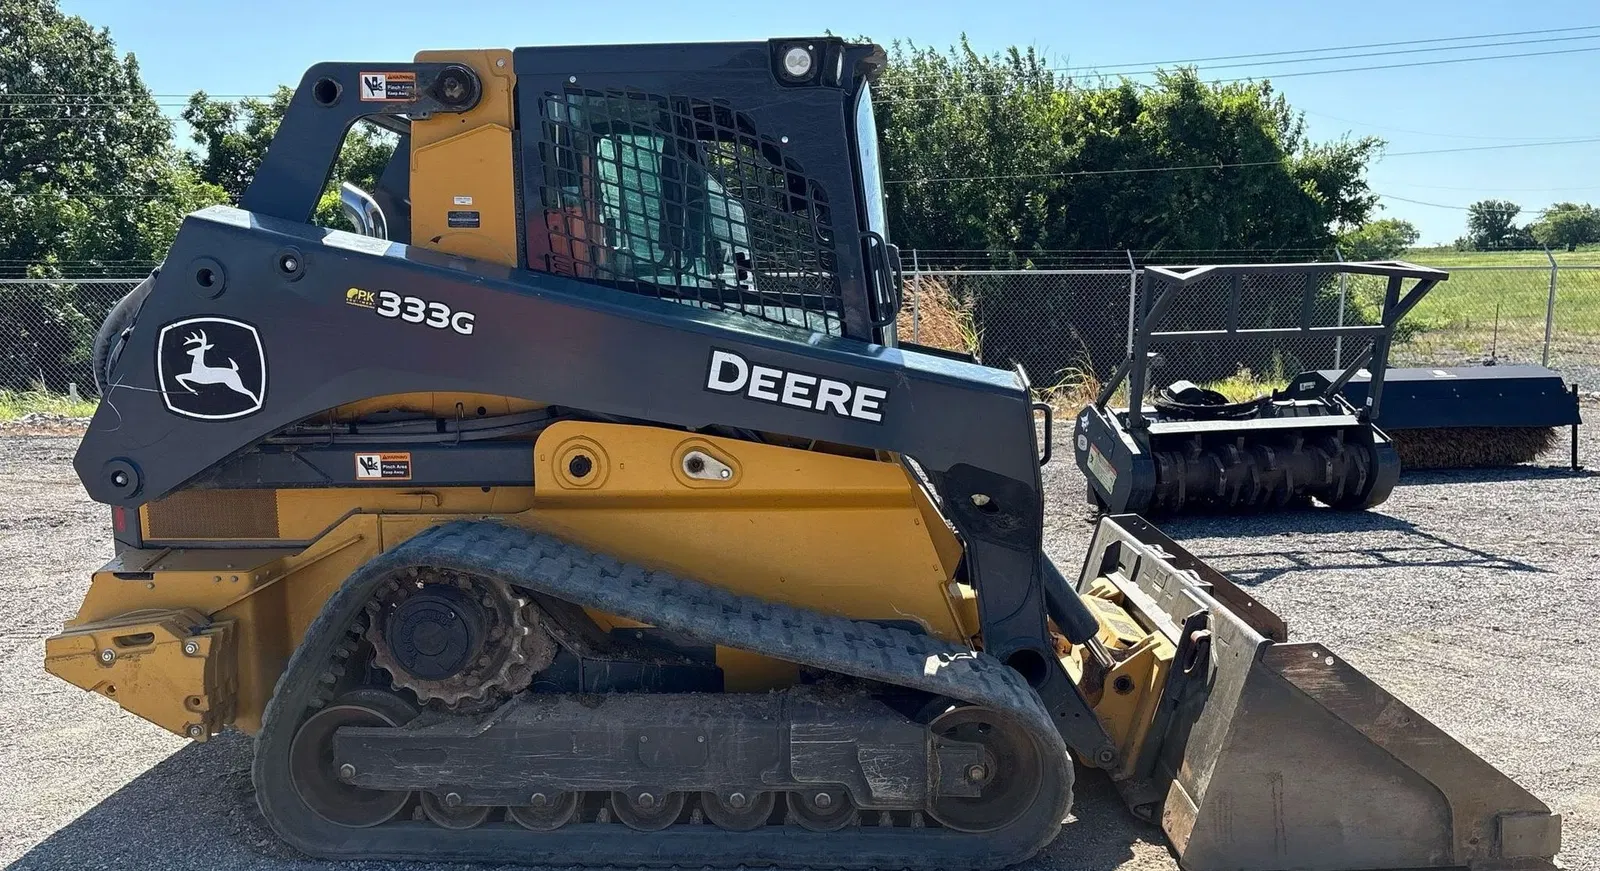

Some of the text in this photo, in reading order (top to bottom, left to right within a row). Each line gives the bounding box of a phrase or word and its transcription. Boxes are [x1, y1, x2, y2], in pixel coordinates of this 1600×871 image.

[358, 290, 375, 302] PK
[377, 291, 475, 335] 333G
[707, 350, 887, 422] DEERE
